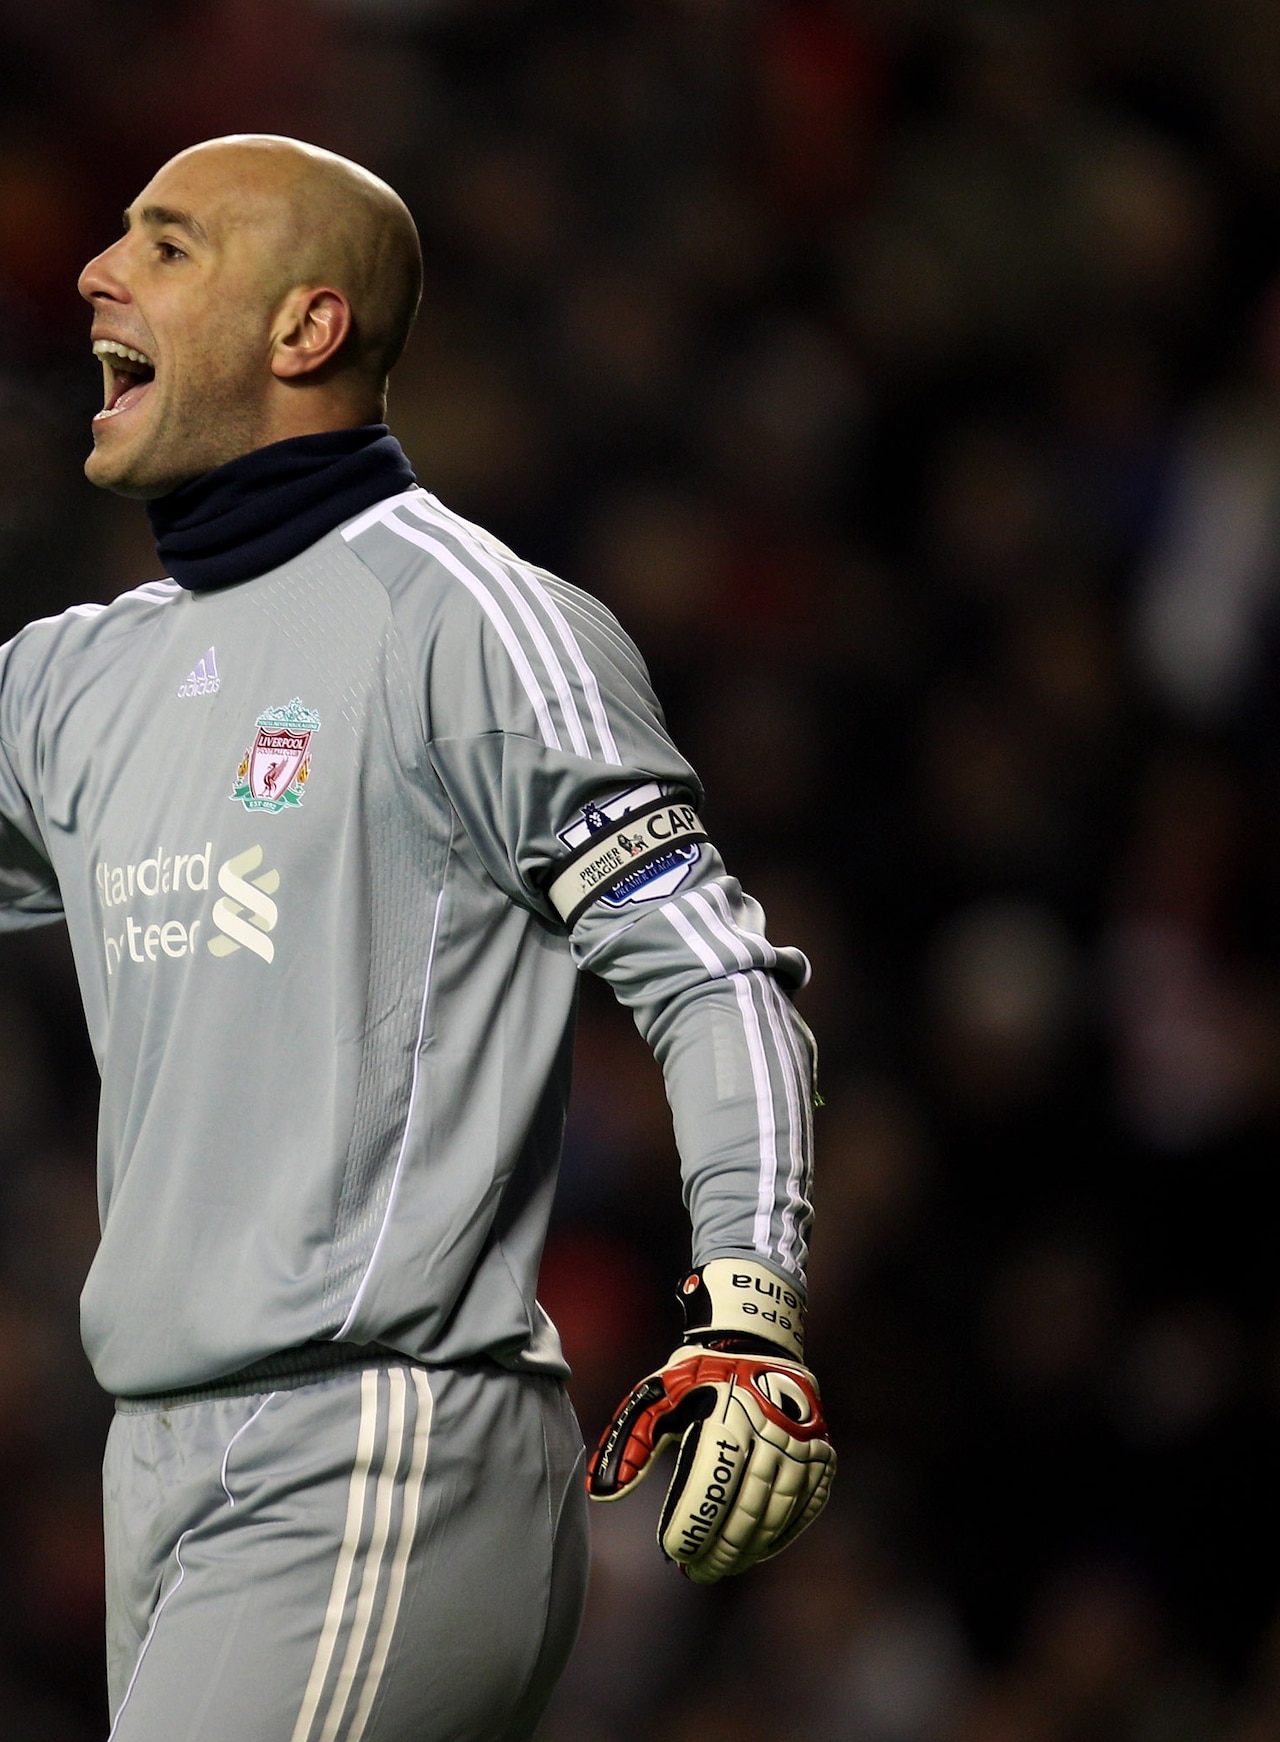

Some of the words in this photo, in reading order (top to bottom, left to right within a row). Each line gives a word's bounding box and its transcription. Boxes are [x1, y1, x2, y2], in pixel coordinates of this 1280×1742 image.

[176, 677, 221, 698] adidas
[257, 748, 284, 756] FOOTBALL
[258, 736, 305, 749] LIVERPOOL
[646, 806, 696, 840] CAP
[579, 847, 620, 881] PREMIER
[586, 855, 624, 887] LEAGUE
[731, 1273, 798, 1310] eina
[677, 1439, 740, 1556] uhlsport
